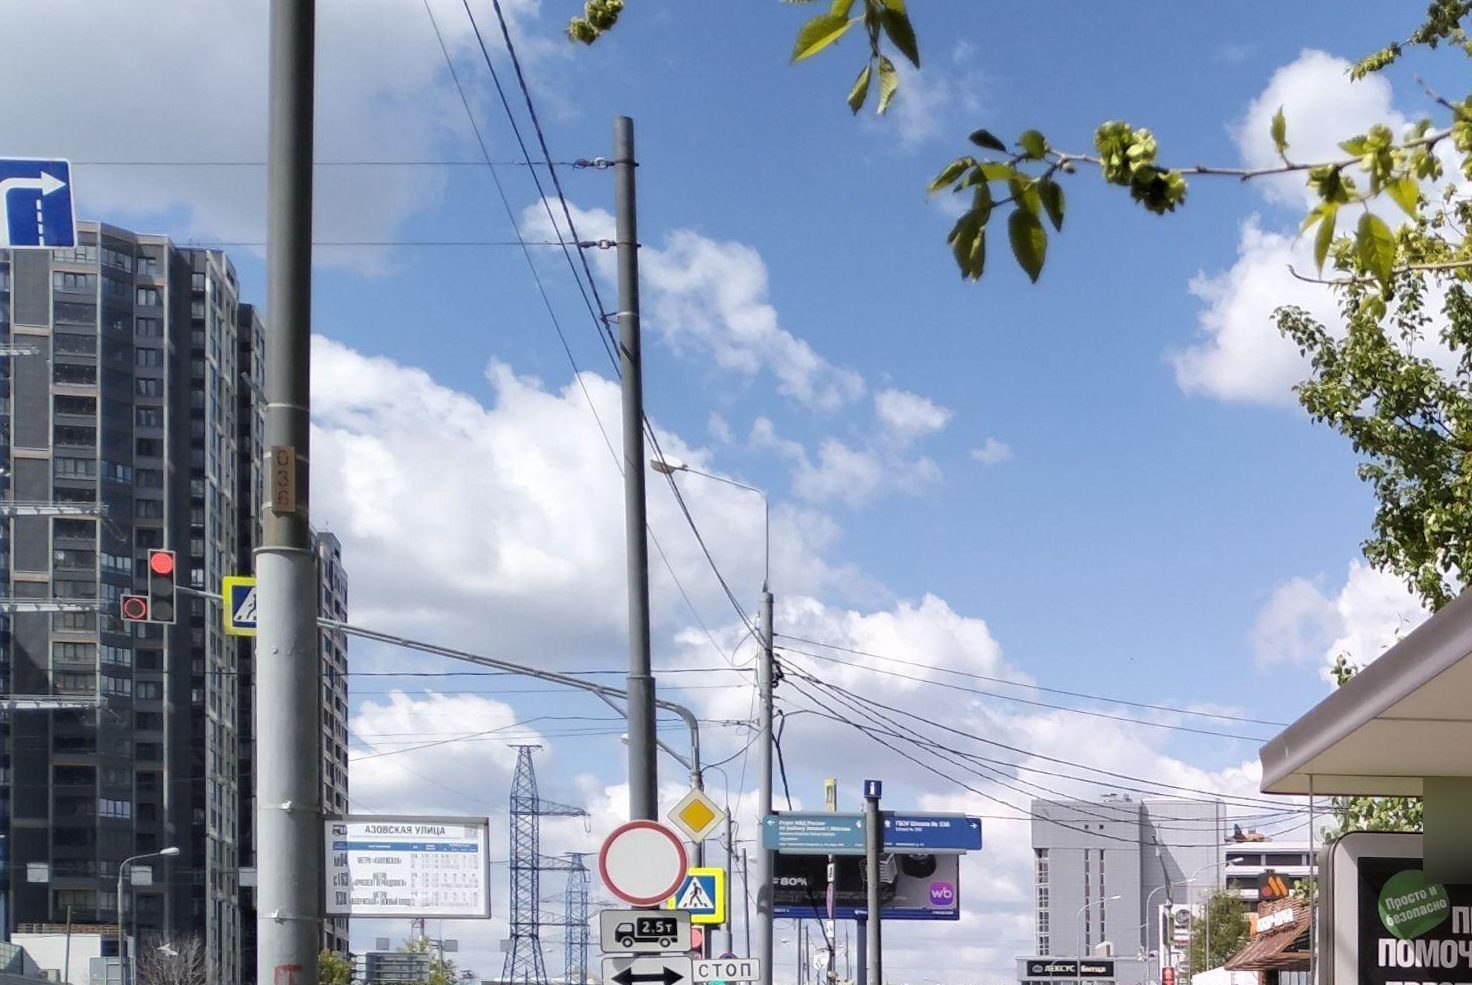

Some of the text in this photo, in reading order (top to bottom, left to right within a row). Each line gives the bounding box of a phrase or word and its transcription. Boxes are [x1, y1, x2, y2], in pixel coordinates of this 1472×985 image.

[364, 824, 446, 837] АЗОВСКАЯ УЛИЦА
[931, 886, 953, 899] wb
[1385, 886, 1438, 910] Просто и
[1386, 898, 1448, 927] безопасно
[698, 963, 751, 978] СТОП
[1044, 964, 1076, 972] ЛЕКСУС
